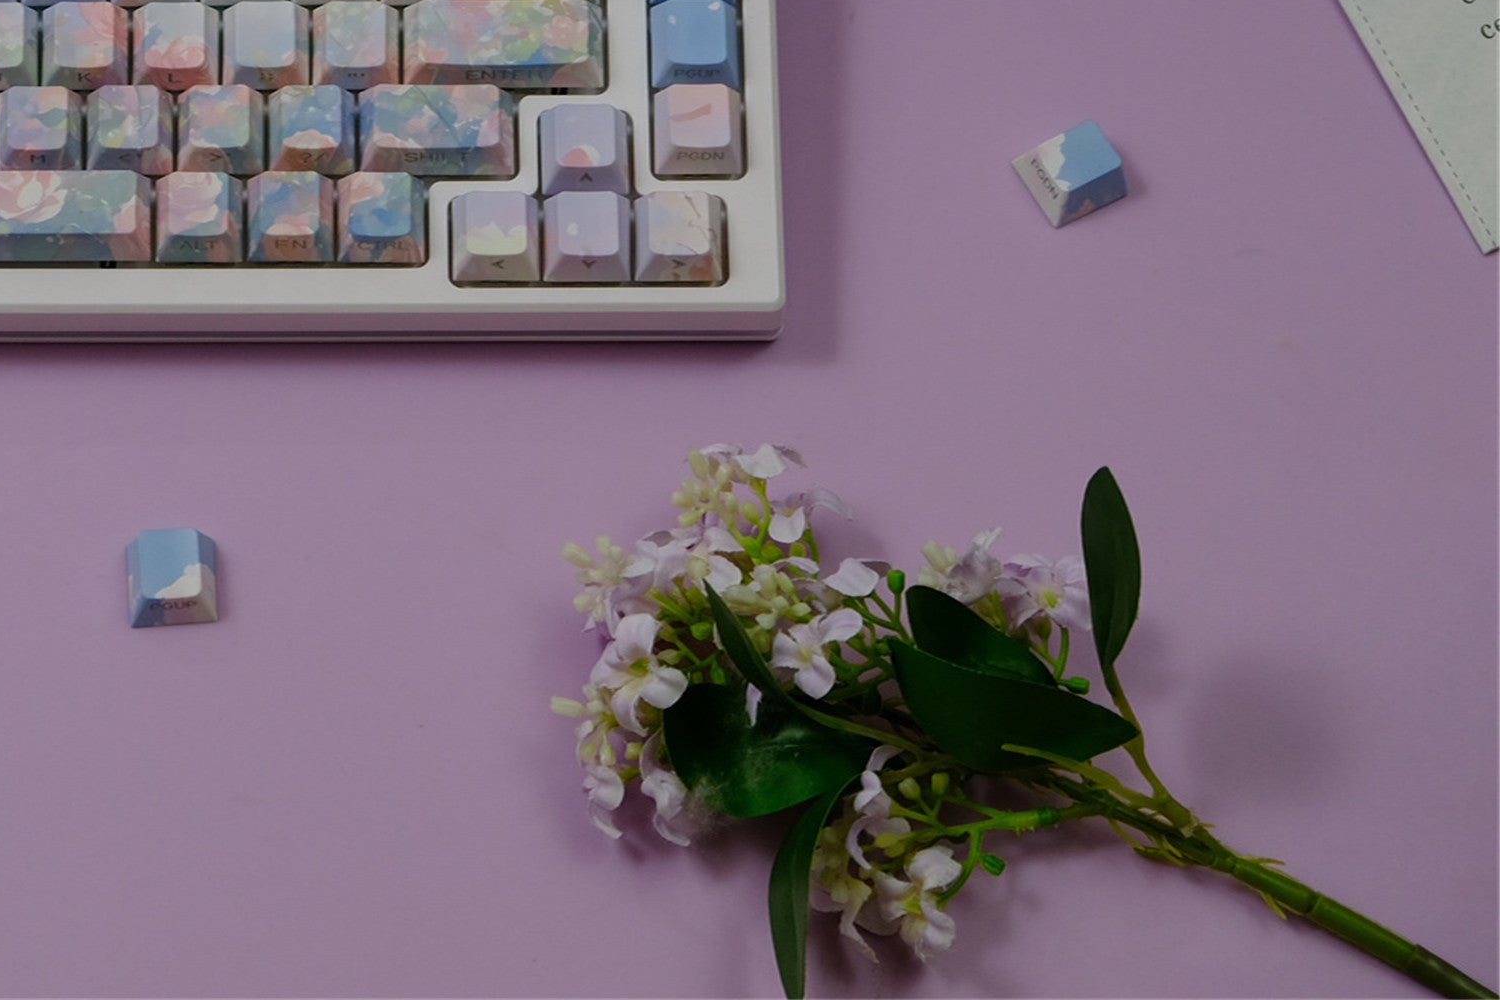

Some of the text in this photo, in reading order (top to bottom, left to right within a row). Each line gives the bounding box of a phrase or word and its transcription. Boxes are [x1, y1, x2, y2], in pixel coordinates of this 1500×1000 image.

[77, 72, 93, 83] K
[465, 69, 546, 81] ENTER
[30, 153, 46, 163] M
[404, 150, 472, 162] SHIFT
[274, 239, 308, 250] FN
